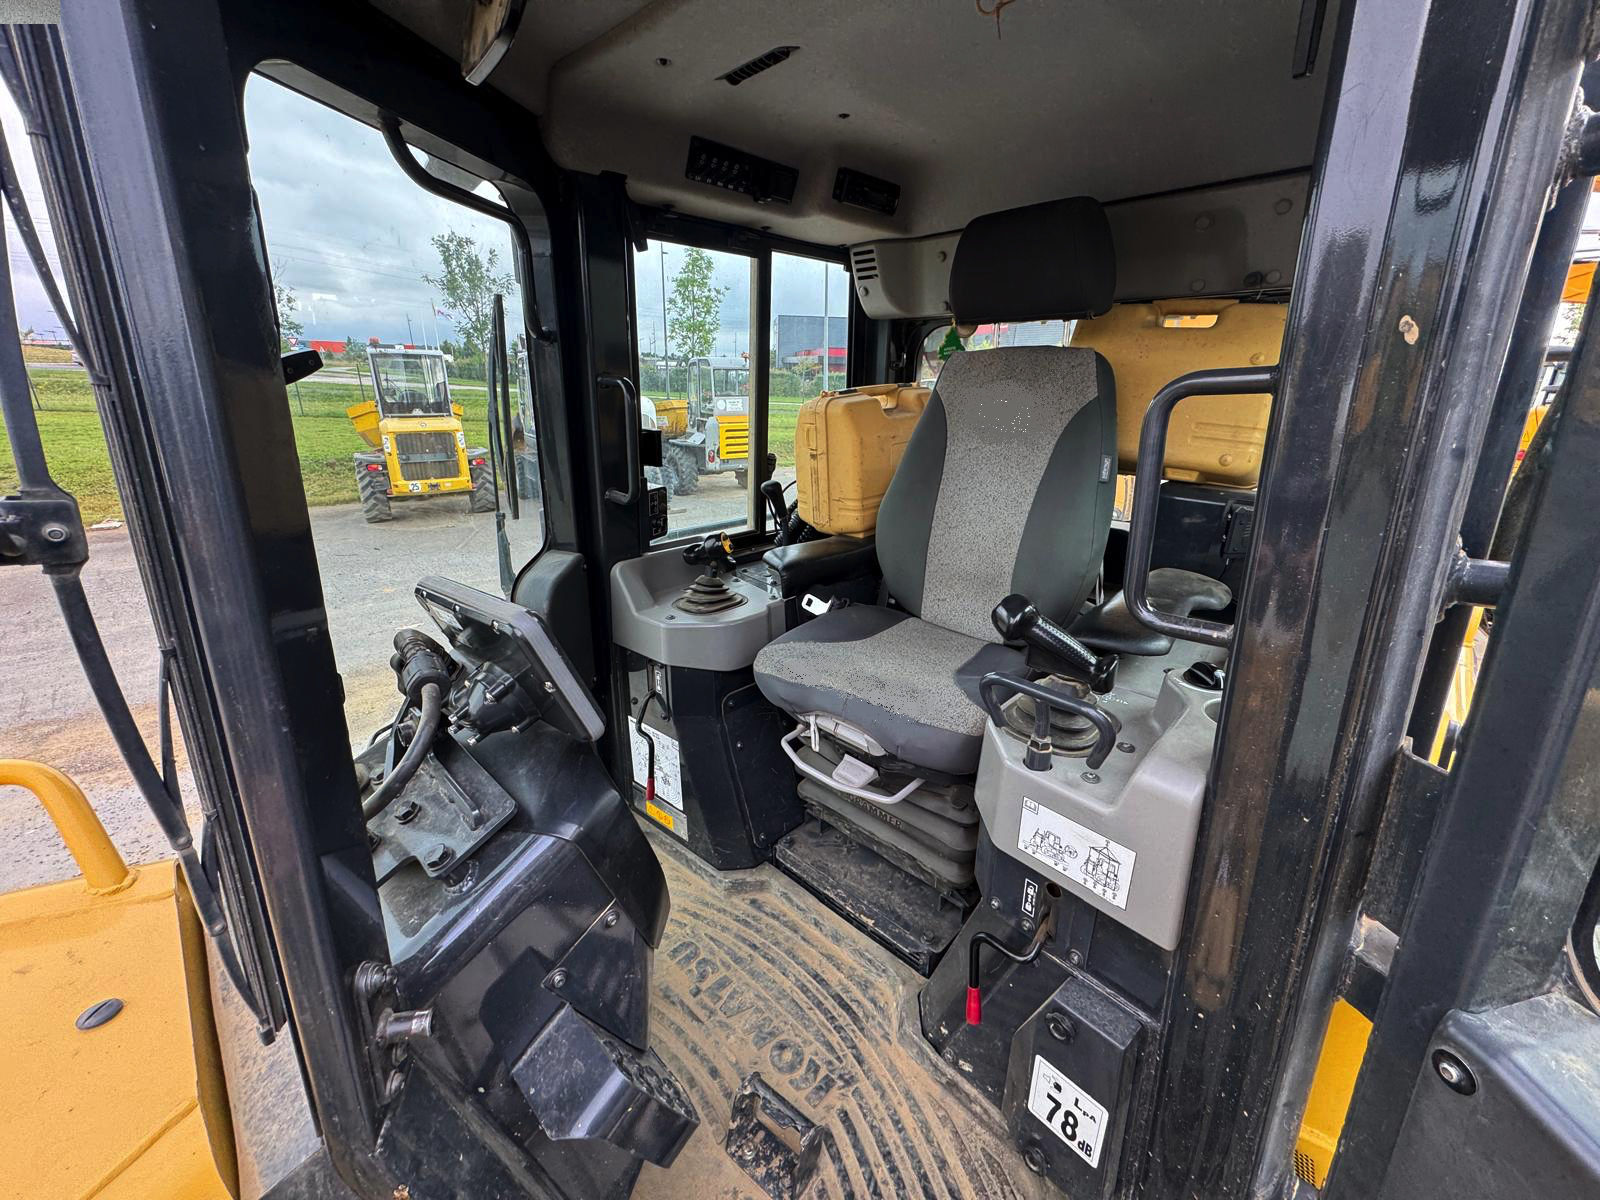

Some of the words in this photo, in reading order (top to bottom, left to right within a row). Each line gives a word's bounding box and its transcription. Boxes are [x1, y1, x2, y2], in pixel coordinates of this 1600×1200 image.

[667, 941, 837, 1108] KOMATSU
[1046, 1093, 1079, 1142] 78
[1077, 1140, 1093, 1158] dB
